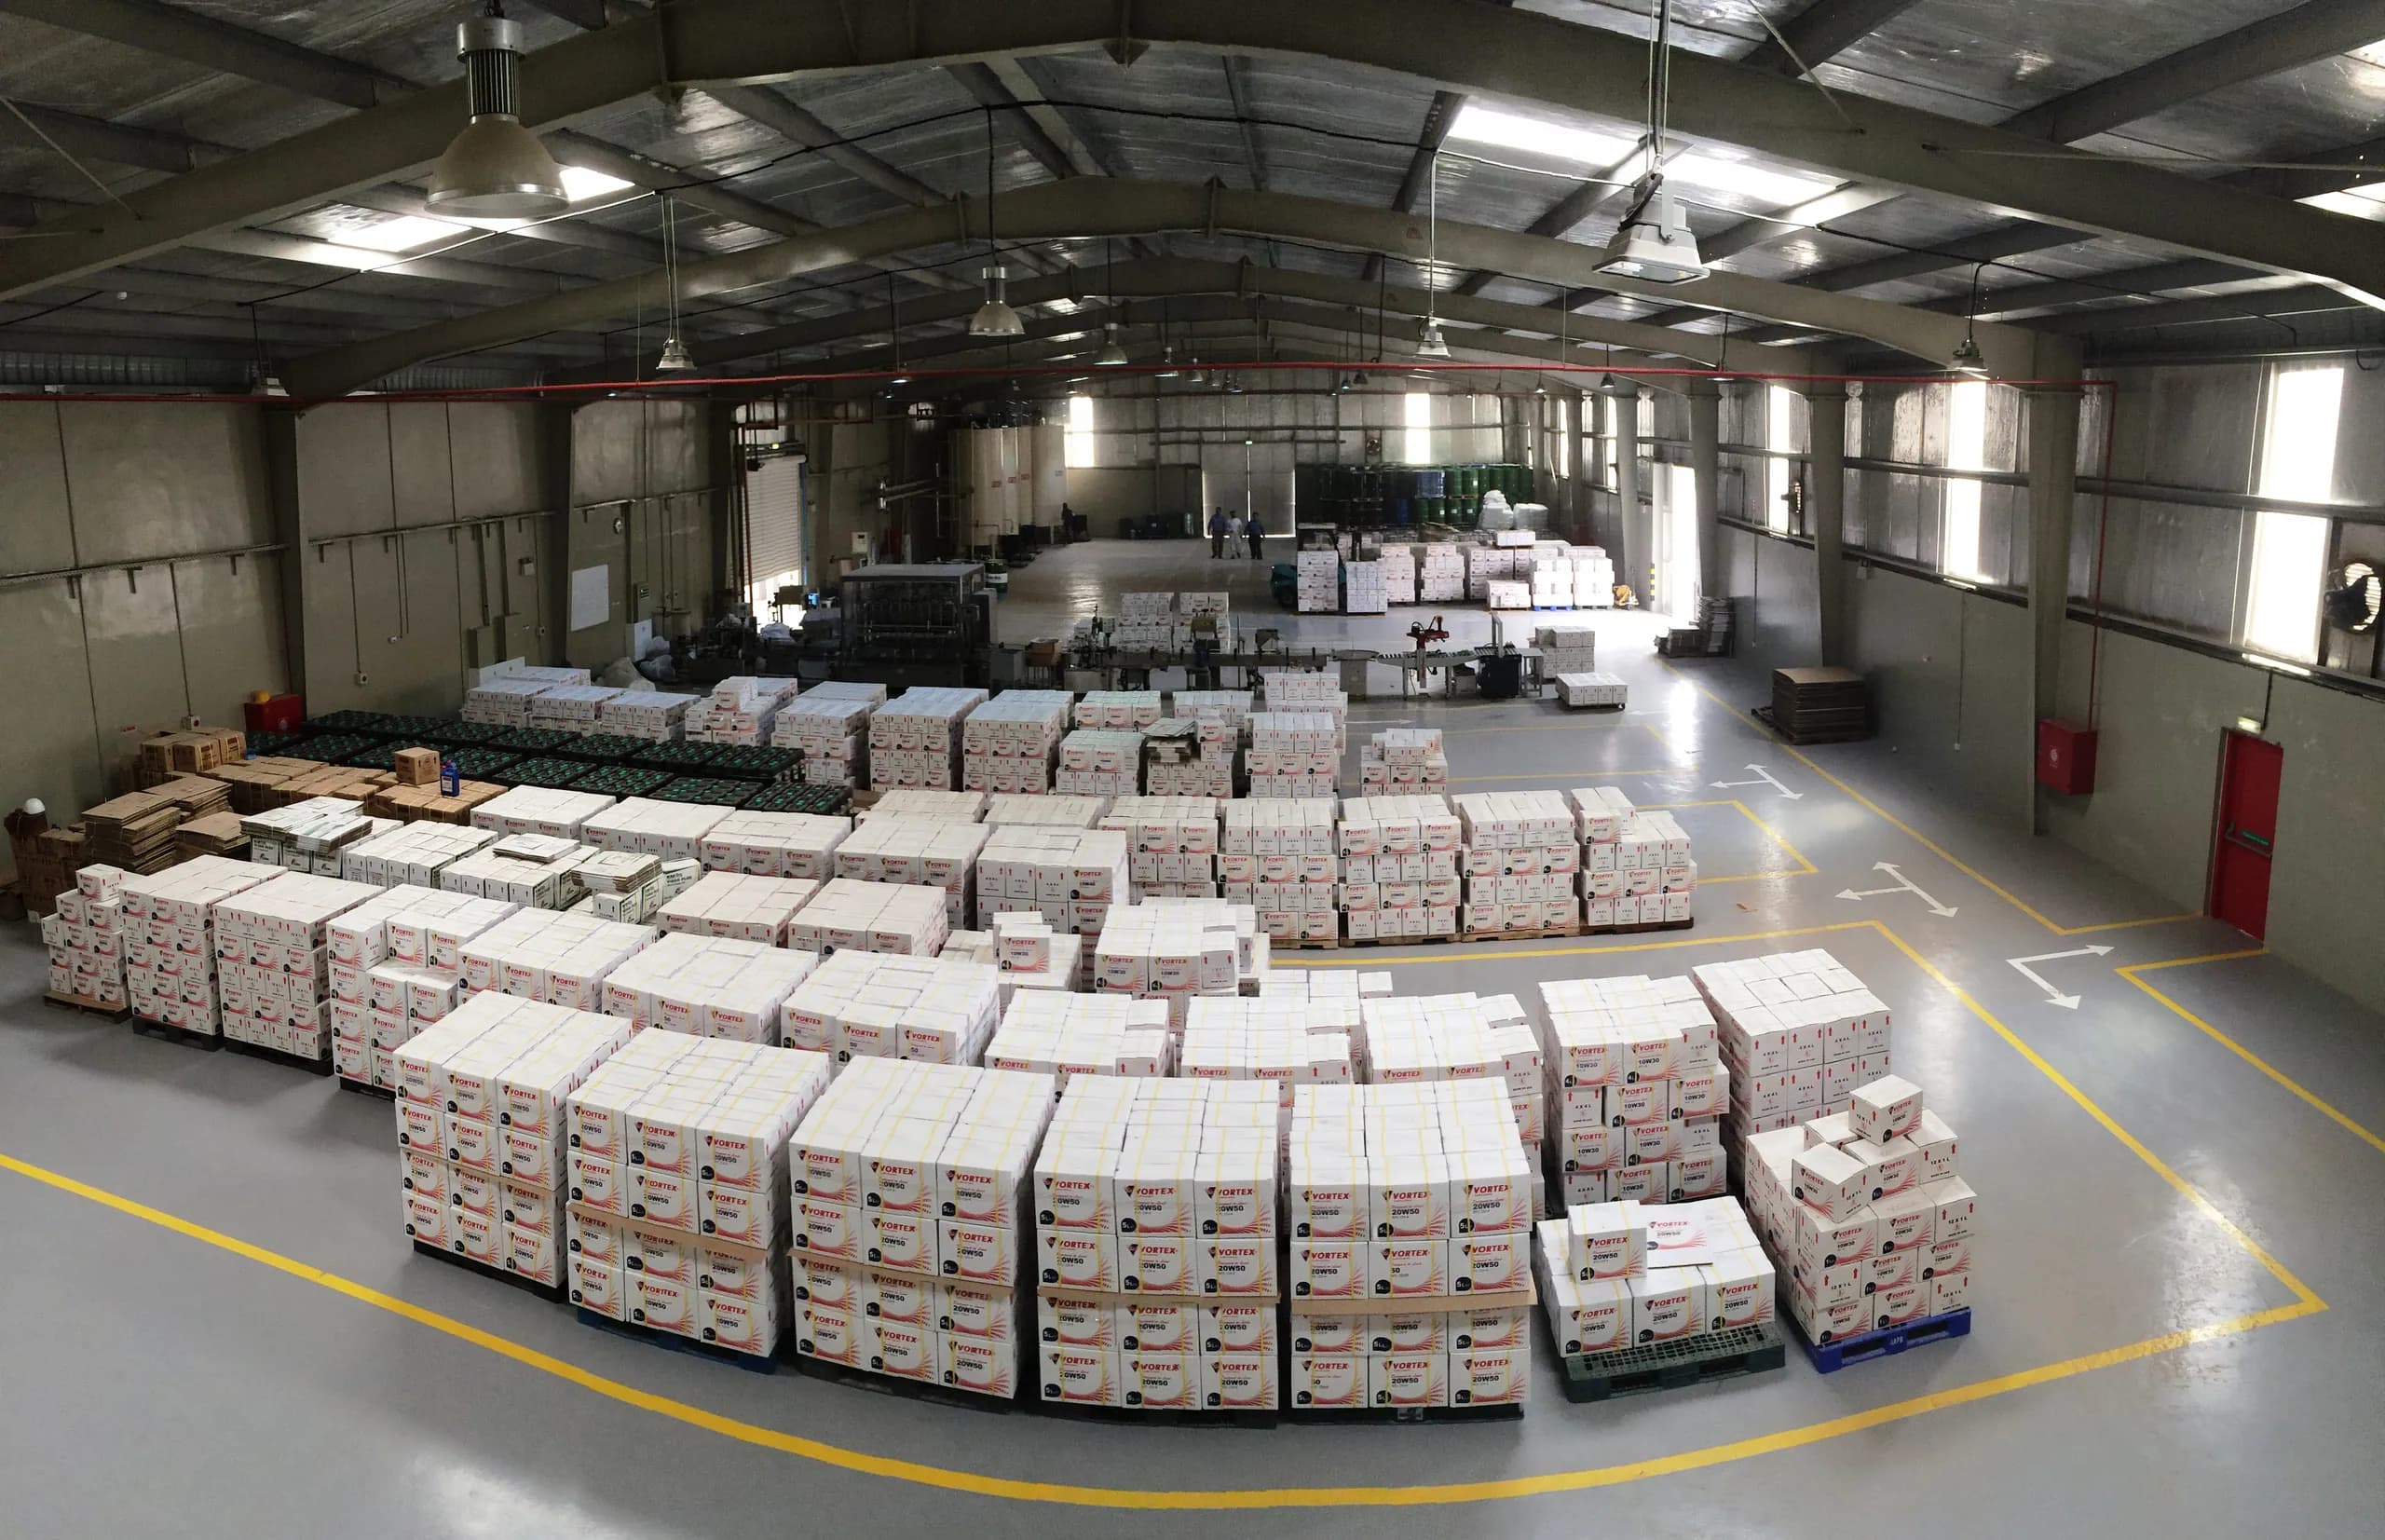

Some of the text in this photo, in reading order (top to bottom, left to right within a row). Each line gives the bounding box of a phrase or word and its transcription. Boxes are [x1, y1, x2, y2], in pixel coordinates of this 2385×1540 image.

[851, 1028, 879, 1038] VORTEX
[912, 1032, 940, 1042] VORTEX
[880, 1165, 914, 1176] VORTEX
[957, 1173, 992, 1184] VORTEX
[1473, 1185, 1510, 1194] VORTEX
[1392, 1192, 1428, 1200] VORTEX
[1473, 1202, 1501, 1210] 20W50
[809, 1208, 842, 1220] VORTEX
[1896, 1215, 1919, 1225] VORTEX
[882, 1220, 916, 1233] VORTEX
[1837, 1228, 1862, 1239] VORTEX
[1594, 1236, 1629, 1246] VORTEX
[1219, 1248, 1256, 1257] VORTEX
[1472, 1244, 1509, 1253] VORTEX
[1936, 1242, 1959, 1253] VORTEX
[1312, 1251, 1349, 1260] VORTEX
[1392, 1249, 1428, 1258] VORTEX
[1593, 1252, 1618, 1261] 20W50
[1878, 1256, 1901, 1267] VORTEX
[713, 1263, 735, 1274] 20W50
[880, 1275, 915, 1288] VORTEX
[1725, 1283, 1758, 1294] VORTEX
[1892, 1289, 1915, 1301] VORTEX
[1654, 1296, 1687, 1307] VORTEX
[1724, 1299, 1749, 1309] 20W50
[954, 1305, 980, 1315] 20W50
[1583, 1307, 1615, 1317] VORTEX
[1834, 1304, 1858, 1315] VORTEX
[1653, 1312, 1678, 1322] 20W50
[884, 1330, 917, 1343] VORTEX
[883, 1346, 908, 1356] 20W50
[957, 1359, 983, 1370] 20W50
[1222, 1363, 1259, 1371] VORTEX
[1473, 1374, 1500, 1383] 20W50
